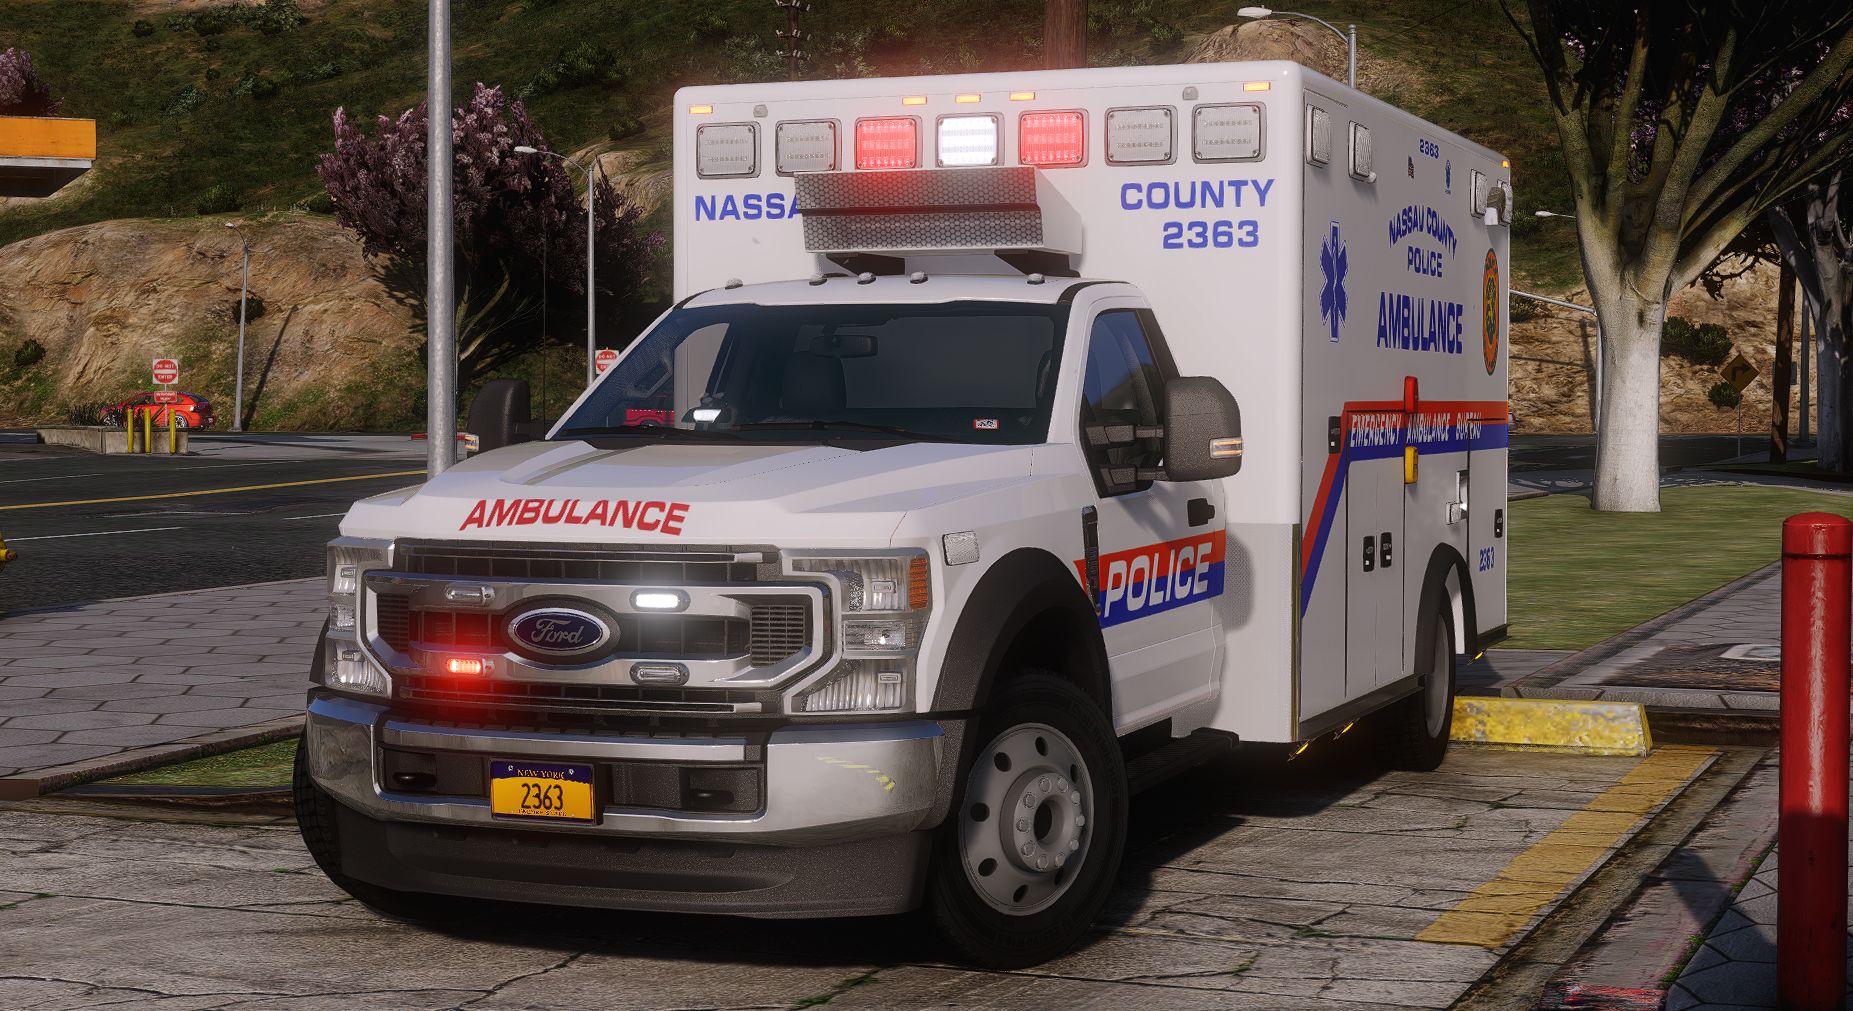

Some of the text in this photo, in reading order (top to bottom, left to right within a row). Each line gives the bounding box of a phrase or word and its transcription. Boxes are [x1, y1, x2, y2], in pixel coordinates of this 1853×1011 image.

[1419, 138, 1439, 160] 2363
[1120, 178, 1275, 210] COUNTY
[1162, 219, 1259, 250] 2363
[1388, 204, 1458, 260] NASSAU COUNTY
[1407, 245, 1443, 279] POLICE
[1376, 291, 1464, 354] AMBULANCE
[1350, 412, 1403, 448] EMERGENCY
[1406, 411, 1452, 444] AMBULANCE
[458, 498, 690, 536] AMBULANCE
[1479, 546, 1495, 572] 2363
[1103, 541, 1213, 619] POLICE
[530, 617, 585, 644] Ford
[517, 768, 565, 780] NEW YORK
[521, 782, 564, 811] 2363
